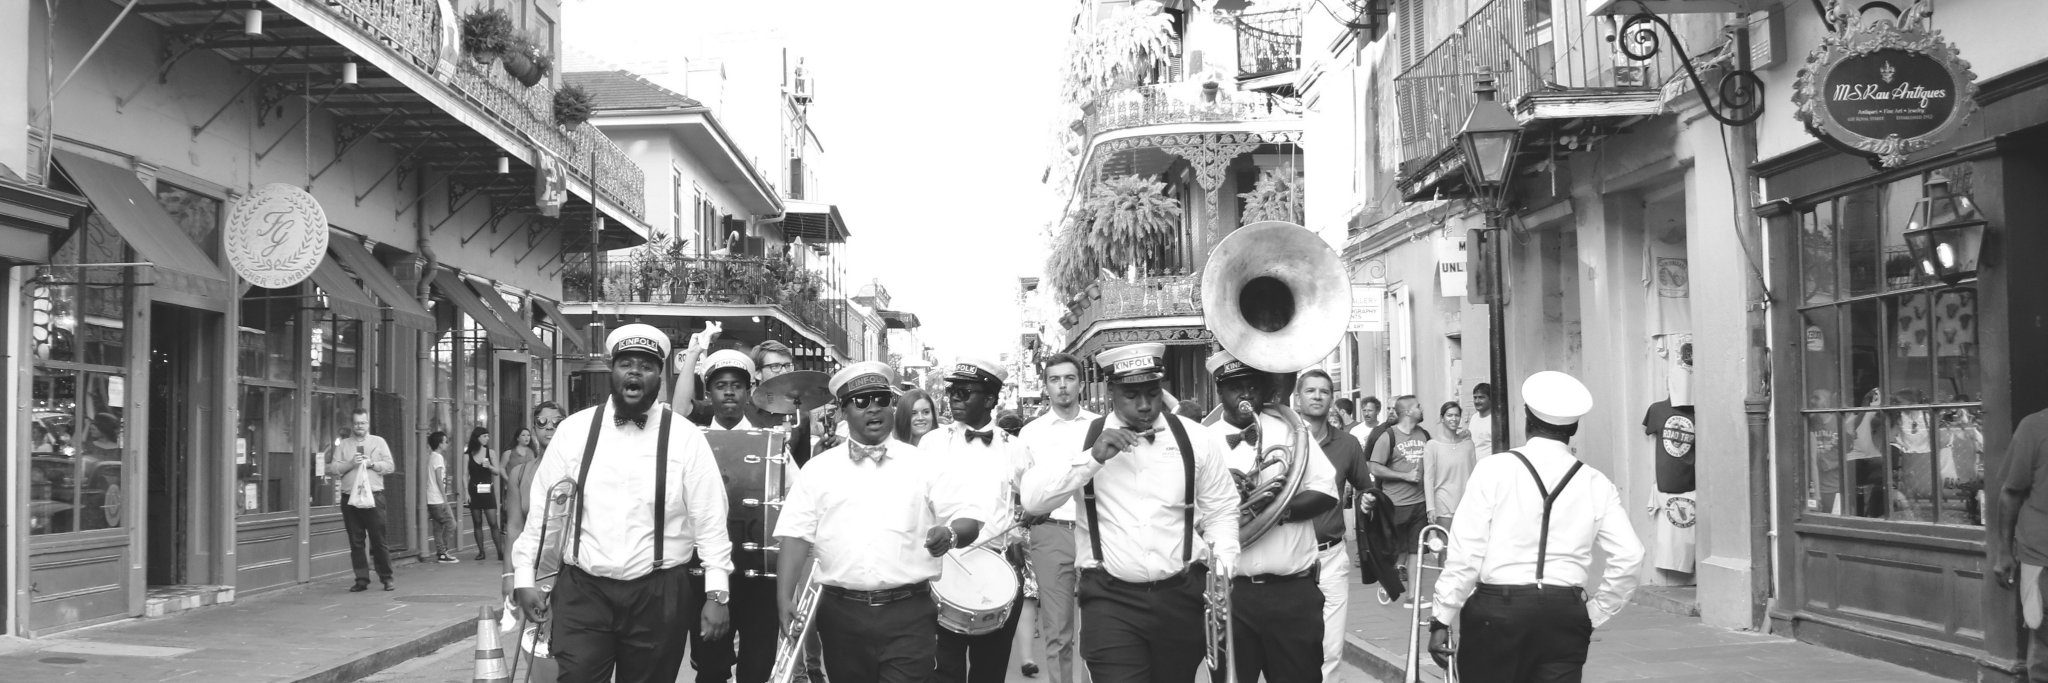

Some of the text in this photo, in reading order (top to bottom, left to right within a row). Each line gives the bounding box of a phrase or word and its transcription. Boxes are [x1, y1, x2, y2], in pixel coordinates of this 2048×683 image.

[1892, 82, 1946, 108] Antiques
[231, 256, 317, 286] FISCHER GAMBINO
[620, 337, 657, 348] KINFOLK
[1115, 357, 1153, 370] KINFOLK
[1663, 429, 1679, 440] ROAD
